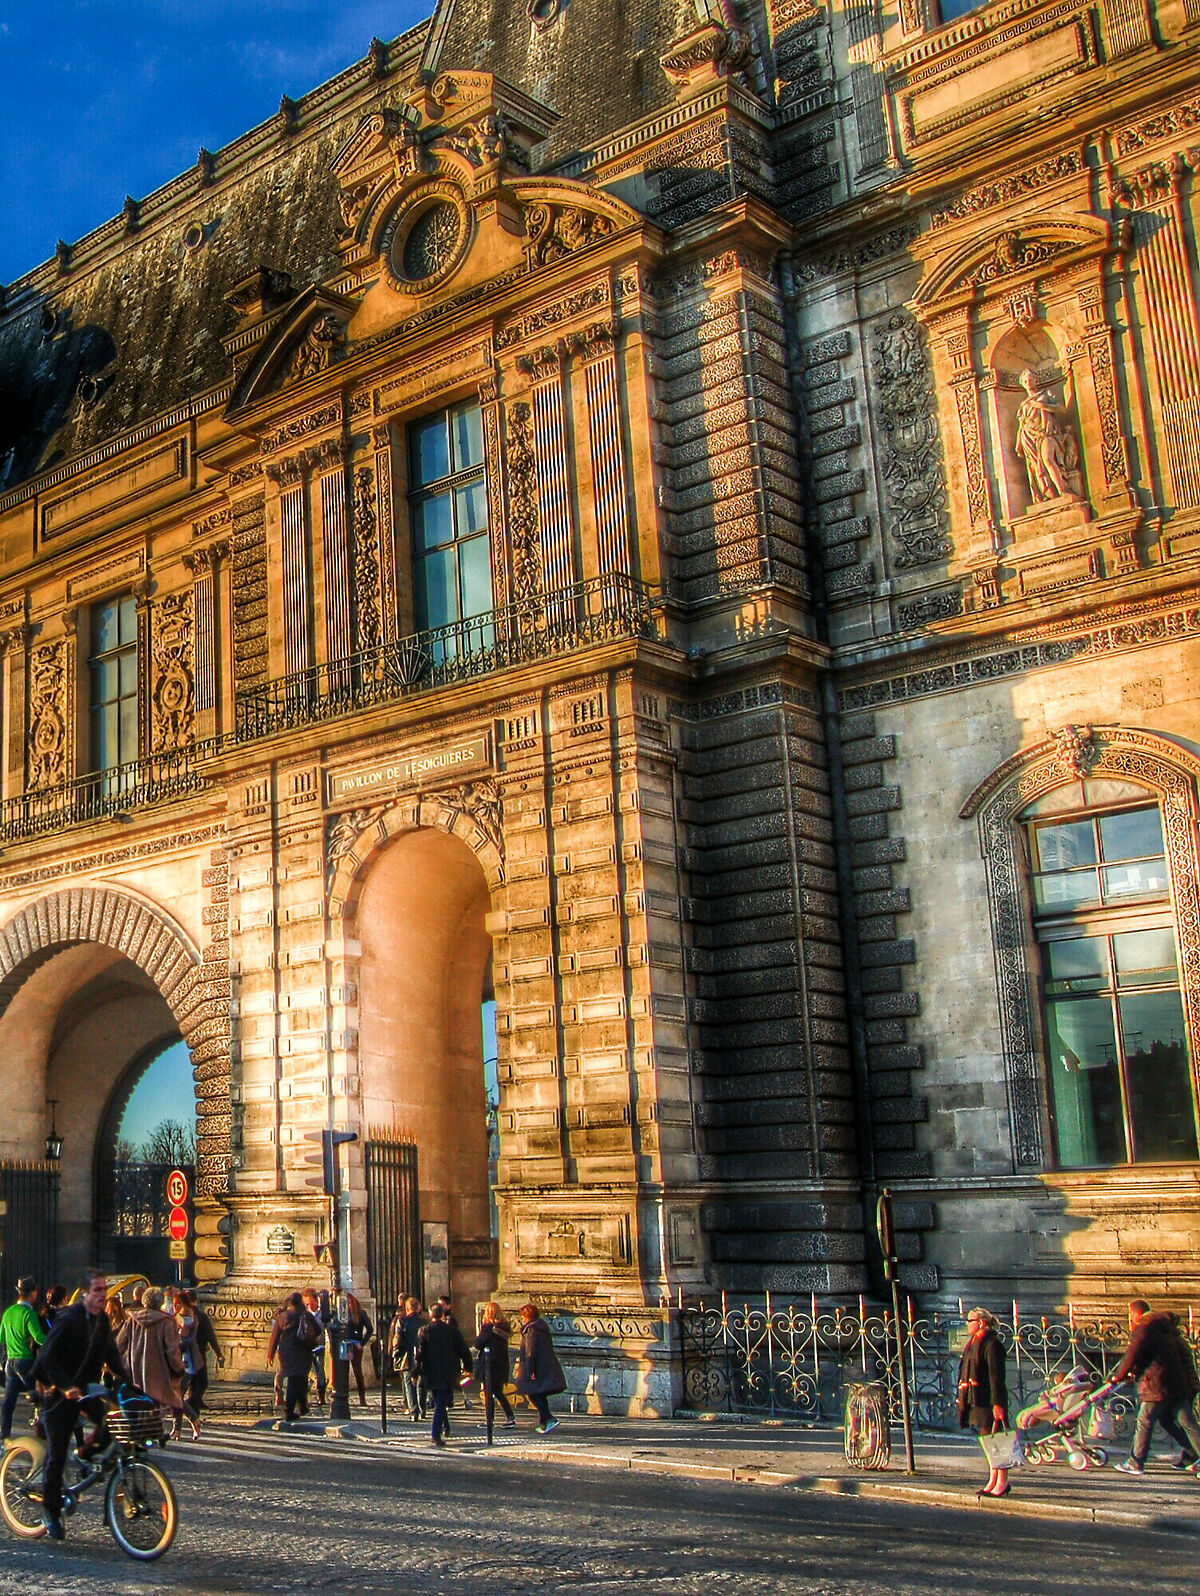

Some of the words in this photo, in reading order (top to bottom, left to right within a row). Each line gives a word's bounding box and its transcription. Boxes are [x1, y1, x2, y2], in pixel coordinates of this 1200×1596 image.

[342, 771, 382, 791] PAVILLON
[387, 767, 400, 780] DE
[172, 1181, 182, 1196] 15
